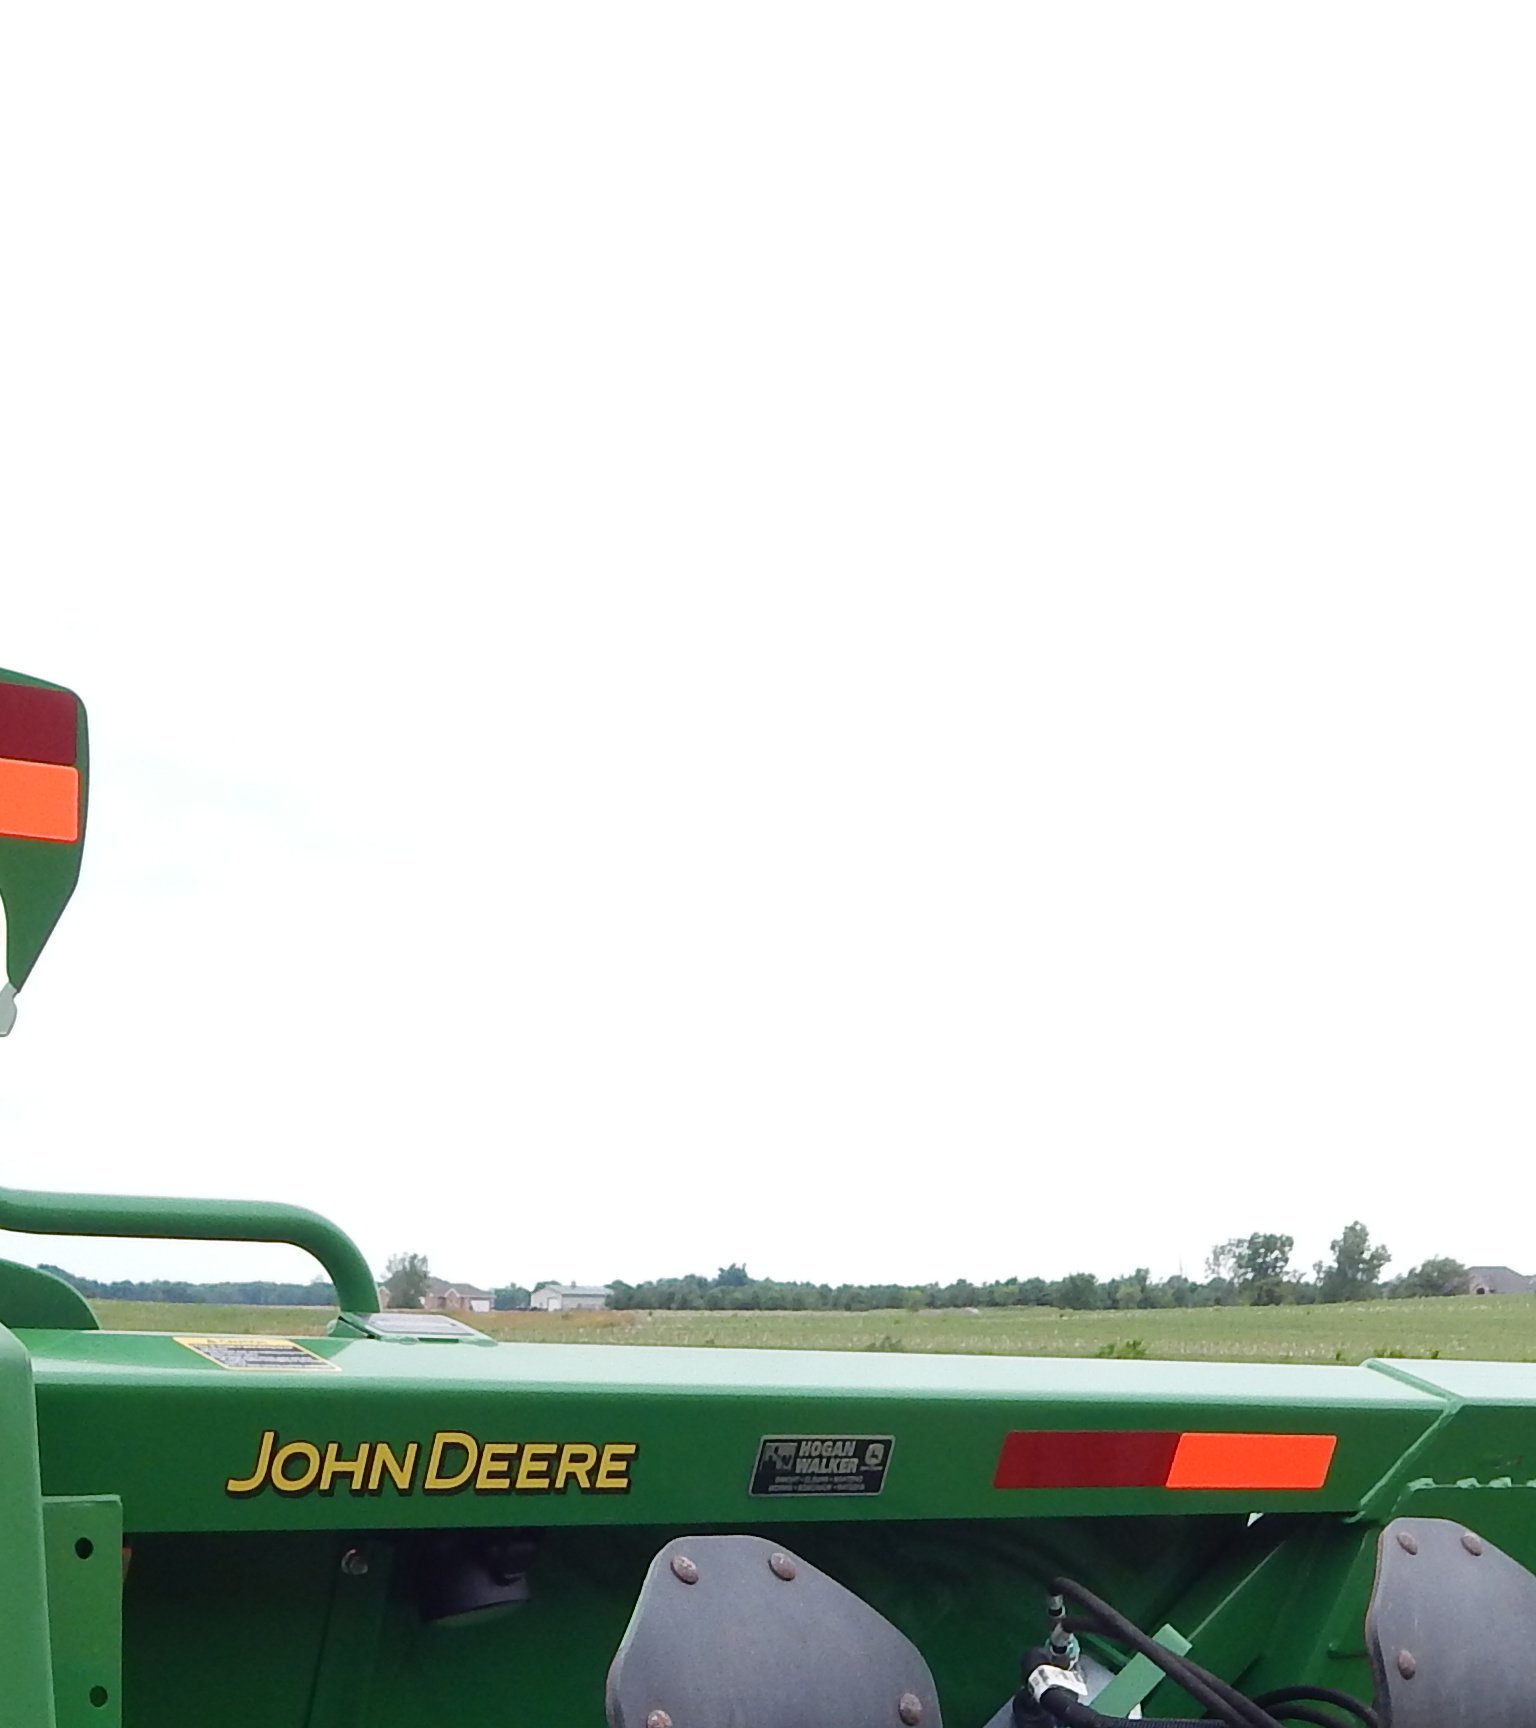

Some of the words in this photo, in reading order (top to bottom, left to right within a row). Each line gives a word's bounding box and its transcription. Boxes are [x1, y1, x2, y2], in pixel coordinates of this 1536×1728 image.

[799, 1441, 856, 1456] HOGAN
[226, 1430, 419, 1493] JOHN
[424, 1431, 637, 1491] DEERE
[795, 1458, 859, 1473] WALKER
